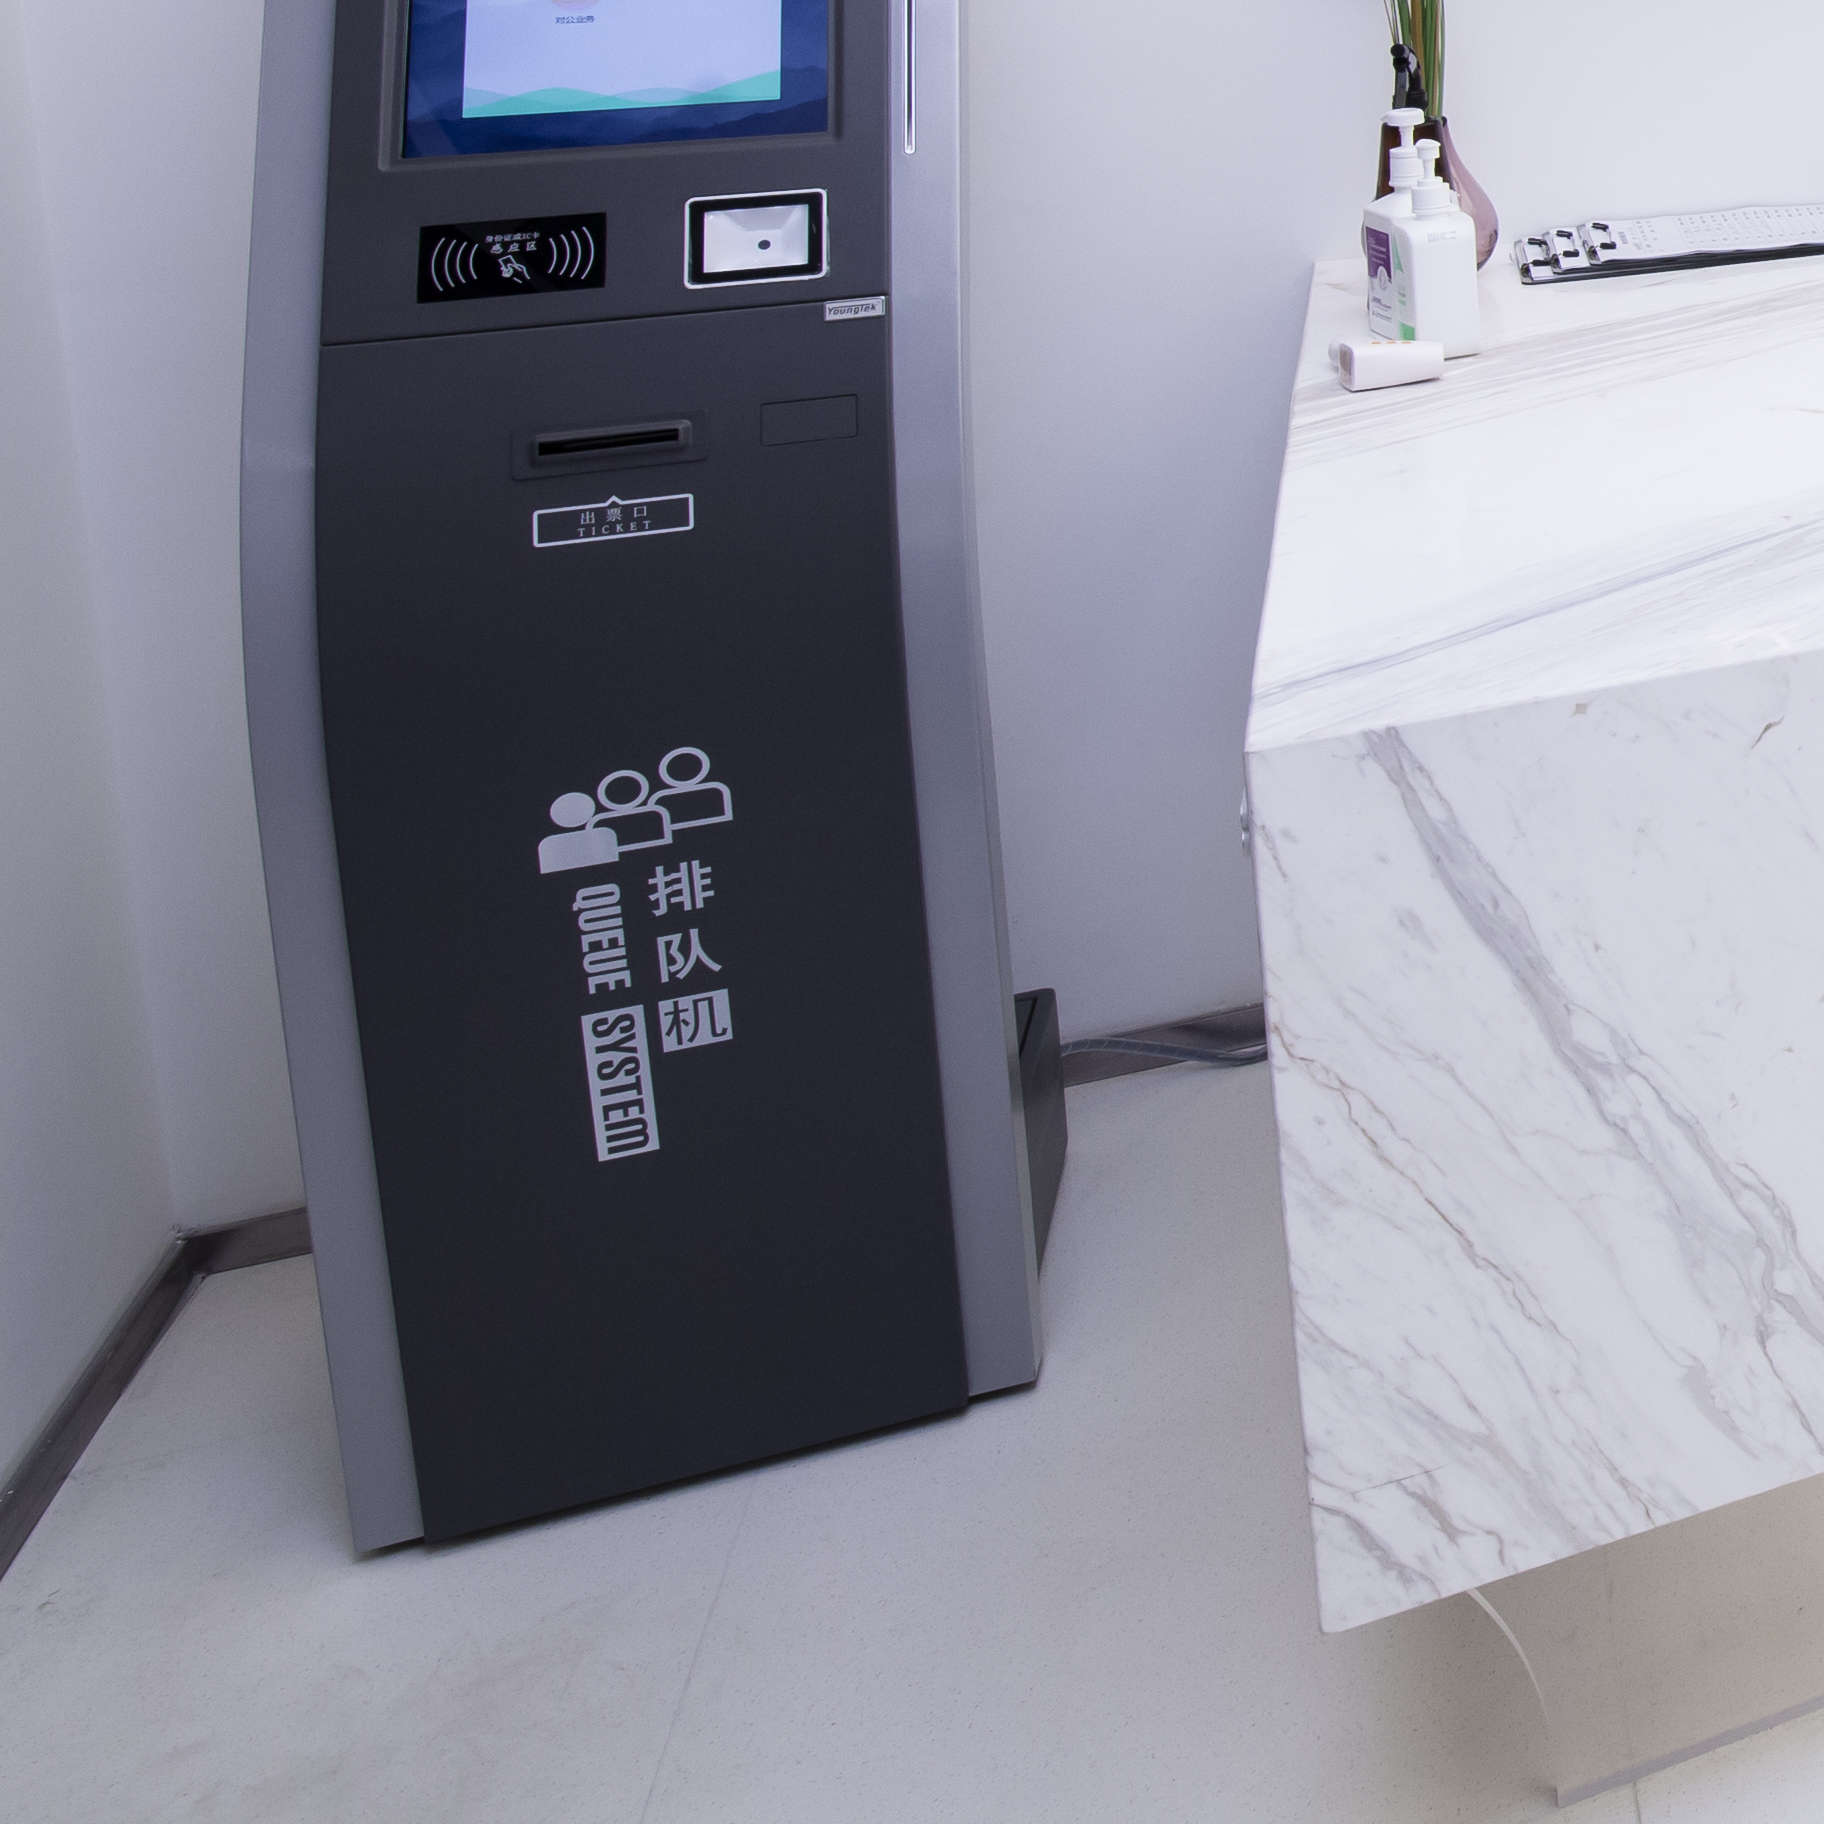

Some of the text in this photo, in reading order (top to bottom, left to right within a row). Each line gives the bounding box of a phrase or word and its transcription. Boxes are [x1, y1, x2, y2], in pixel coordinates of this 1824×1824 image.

[577, 520, 652, 538] TICKET
[580, 505, 647, 525] 出票口
[648, 859, 730, 1047] 排队机
[572, 883, 650, 1156] QUEUE SYSTEM
